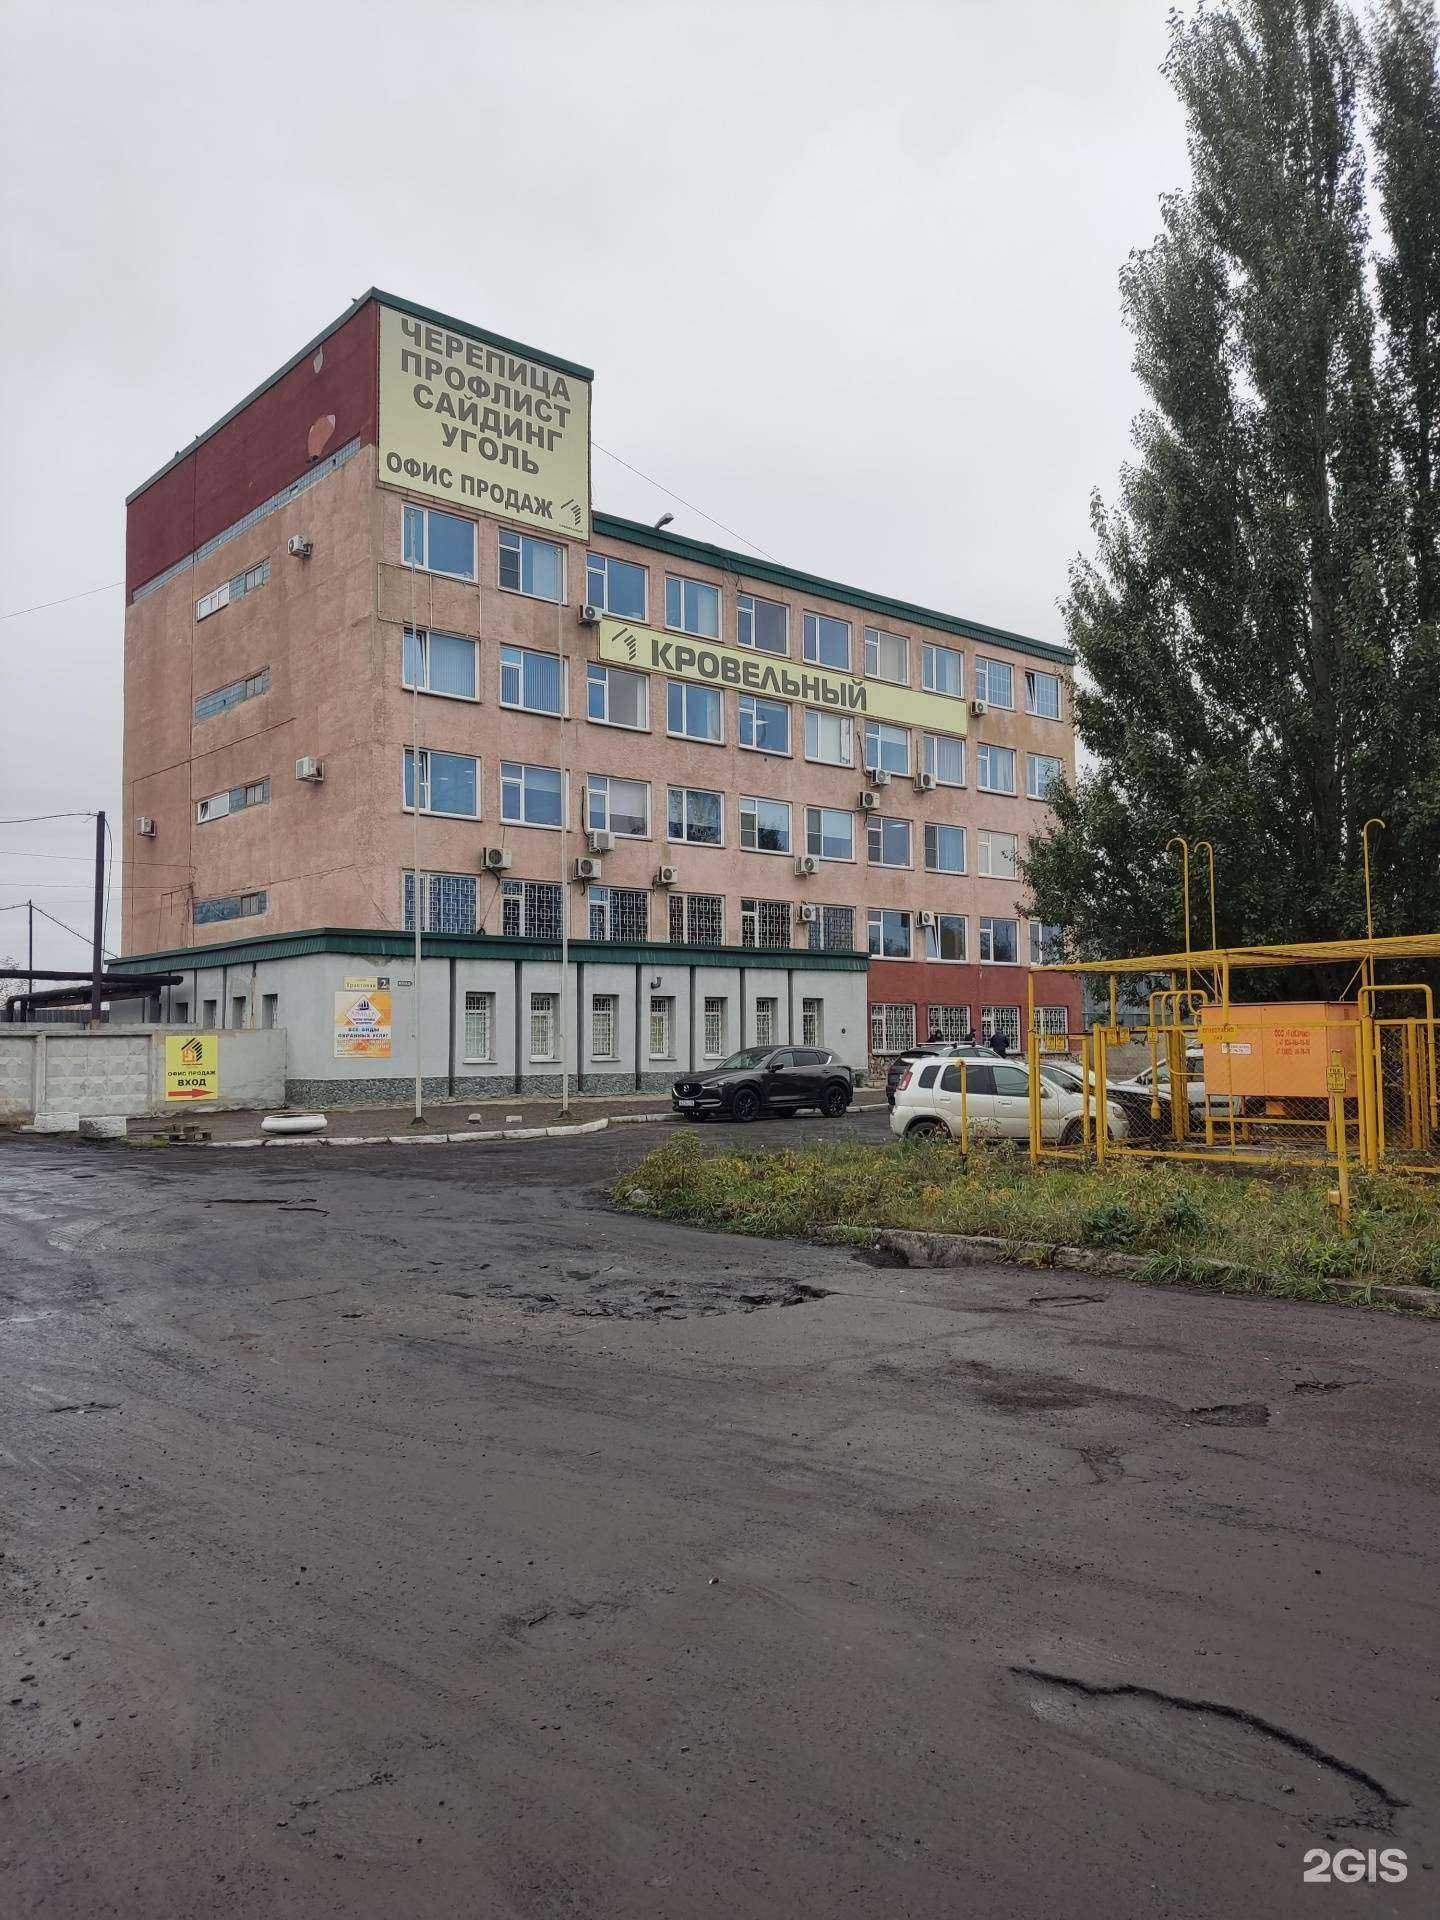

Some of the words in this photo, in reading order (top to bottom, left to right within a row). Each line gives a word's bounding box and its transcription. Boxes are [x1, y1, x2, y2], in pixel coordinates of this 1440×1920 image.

[401, 318, 571, 402] ЧЕРЕПИЦА
[401, 348, 571, 428] ПРОФЛИСТ
[413, 383, 563, 452] САЙДИНГ
[441, 422, 540, 475] УГОЛЬ
[386, 451, 453, 489] ОФИС
[460, 474, 553, 520] ПРОДАЖ
[651, 639, 867, 711] КРОВЕЛЬНЫЙ
[177, 1078, 207, 1087] ВХОД
